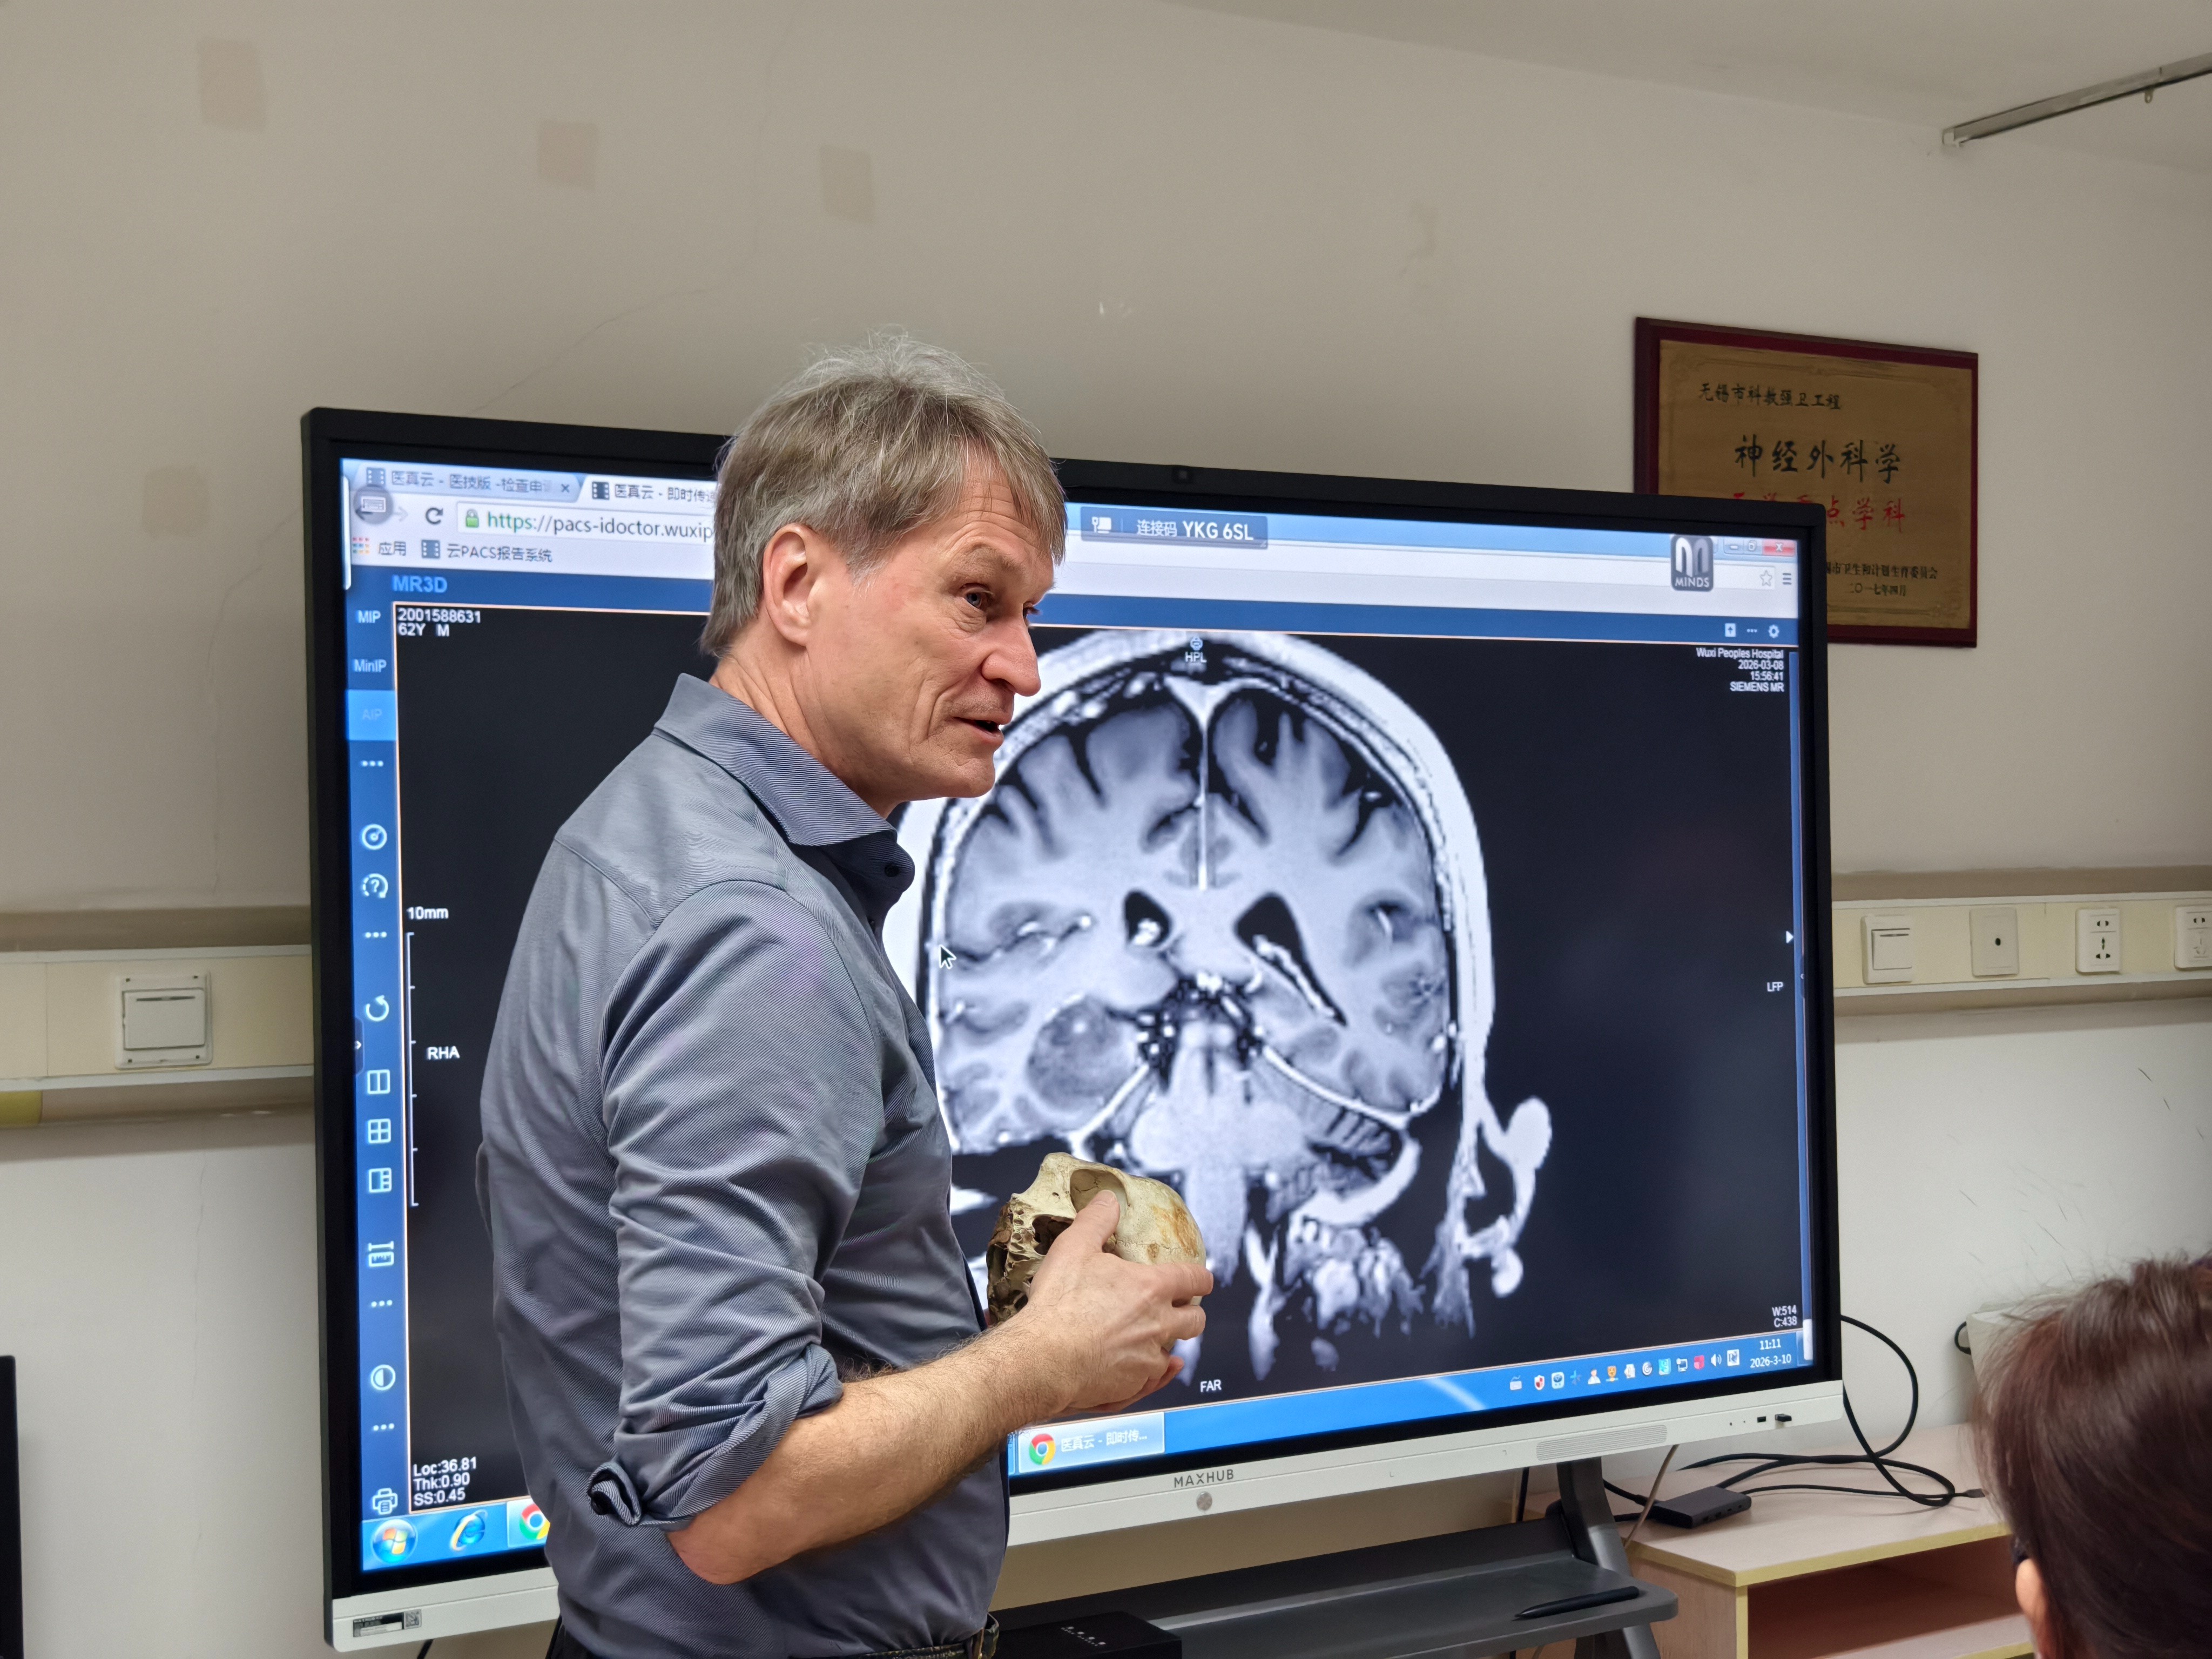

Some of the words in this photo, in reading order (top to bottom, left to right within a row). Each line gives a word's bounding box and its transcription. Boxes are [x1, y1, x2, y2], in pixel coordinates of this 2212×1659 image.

[1735, 434, 1900, 484] 神经外科学
[392, 470, 434, 487] 医真云
[615, 483, 655, 500] 医真云
[1137, 519, 1177, 537] 连接码
[1182, 521, 1218, 539] YKG
[1223, 523, 1254, 541] 6SL
[379, 542, 406, 557] 应用
[447, 543, 552, 563] 云PACS报告系统
[392, 575, 448, 593] MR3D
[1675, 577, 1710, 588] MINDS
[357, 610, 381, 624] MIP
[397, 608, 481, 623] 2001588631
[397, 623, 426, 636] 62Y
[436, 624, 450, 637] M
[1185, 651, 1207, 663] HPL
[1696, 648, 1716, 658] Wuxi
[1717, 648, 1750, 659] Peoples
[1751, 649, 1784, 659] Hospital
[354, 659, 387, 673] MinIP
[1730, 681, 1769, 692] SIEMENS
[1770, 682, 1785, 692] MR
[407, 906, 449, 920] 10mm
[1766, 981, 1784, 992] LFP
[427, 1046, 460, 1060] RHA
[1759, 1338, 1782, 1350] 11:11
[1749, 1353, 1792, 1368] 2026-3-10
[1200, 1379, 1222, 1393] FAR
[1061, 1435, 1095, 1452] 医真云
[1174, 1469, 1235, 1488] MAXHUB
[414, 1488, 466, 1506] SS:0.45
